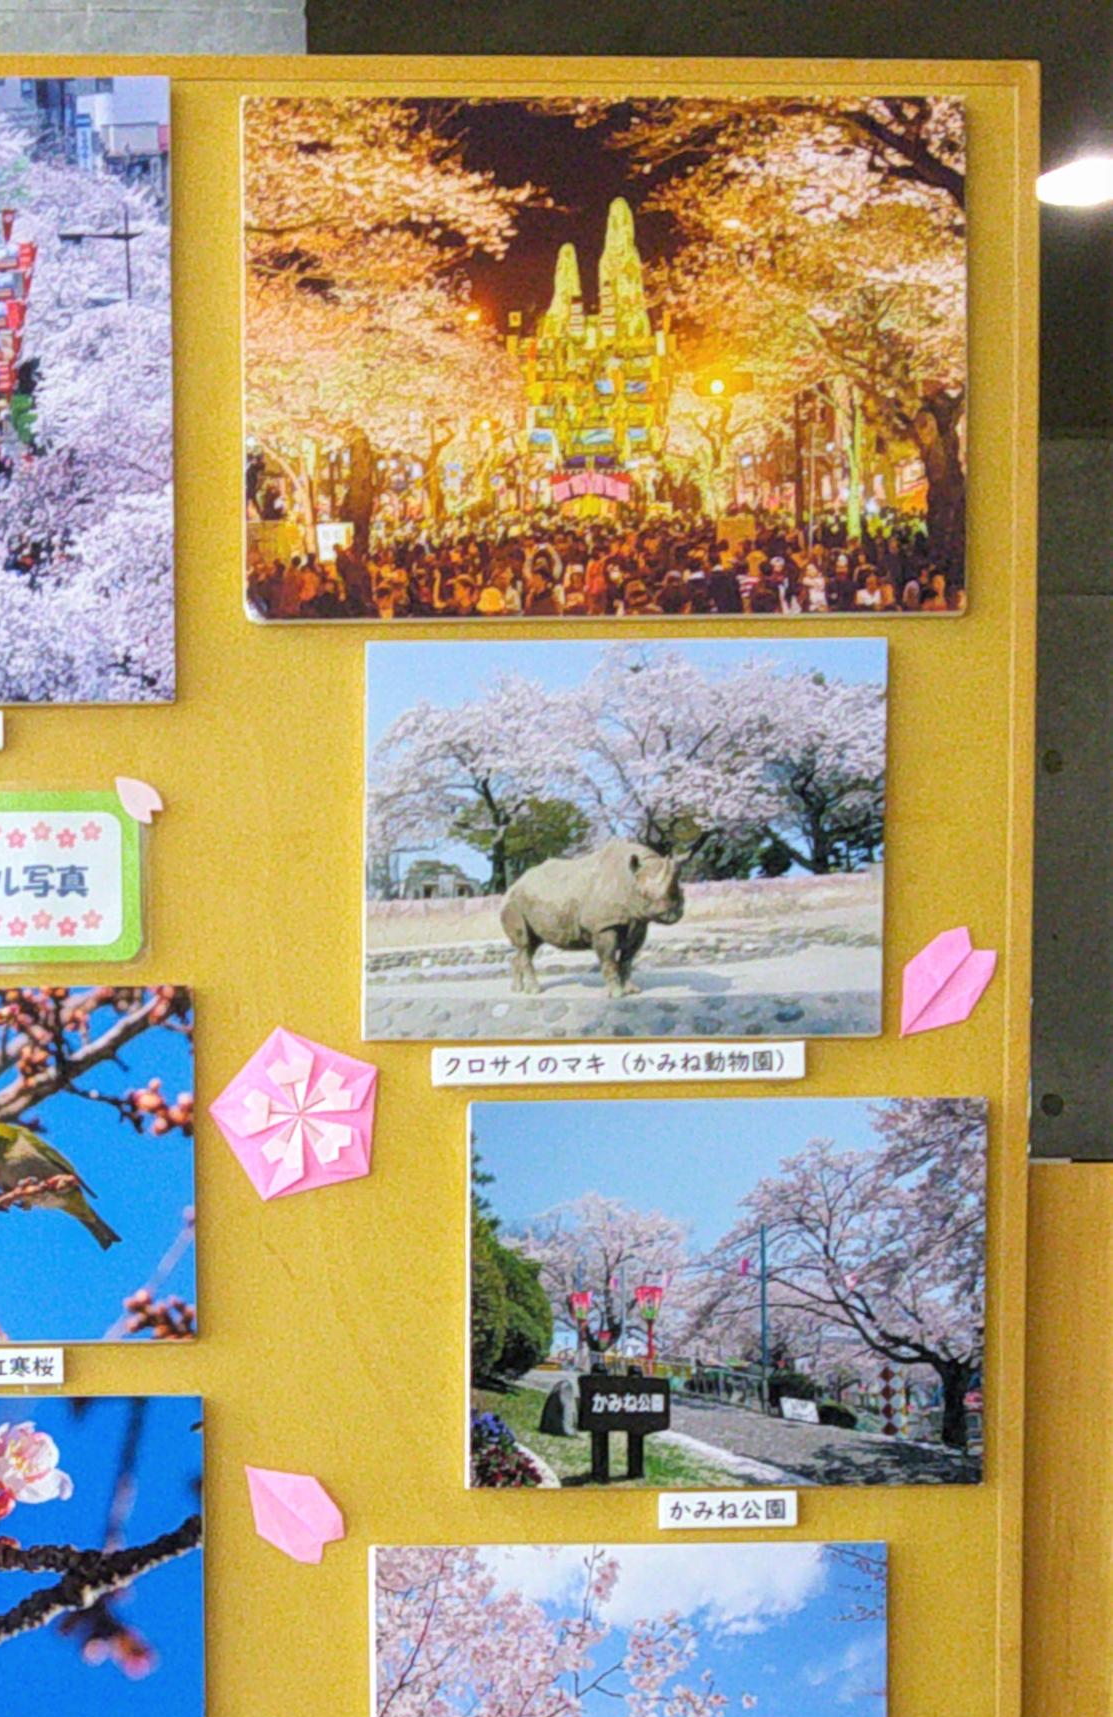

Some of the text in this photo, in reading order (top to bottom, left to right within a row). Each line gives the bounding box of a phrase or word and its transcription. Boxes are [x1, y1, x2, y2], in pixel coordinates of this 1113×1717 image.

[590, 1392, 665, 1415] かみね公園
[669, 1497, 788, 1522] かみね公園
